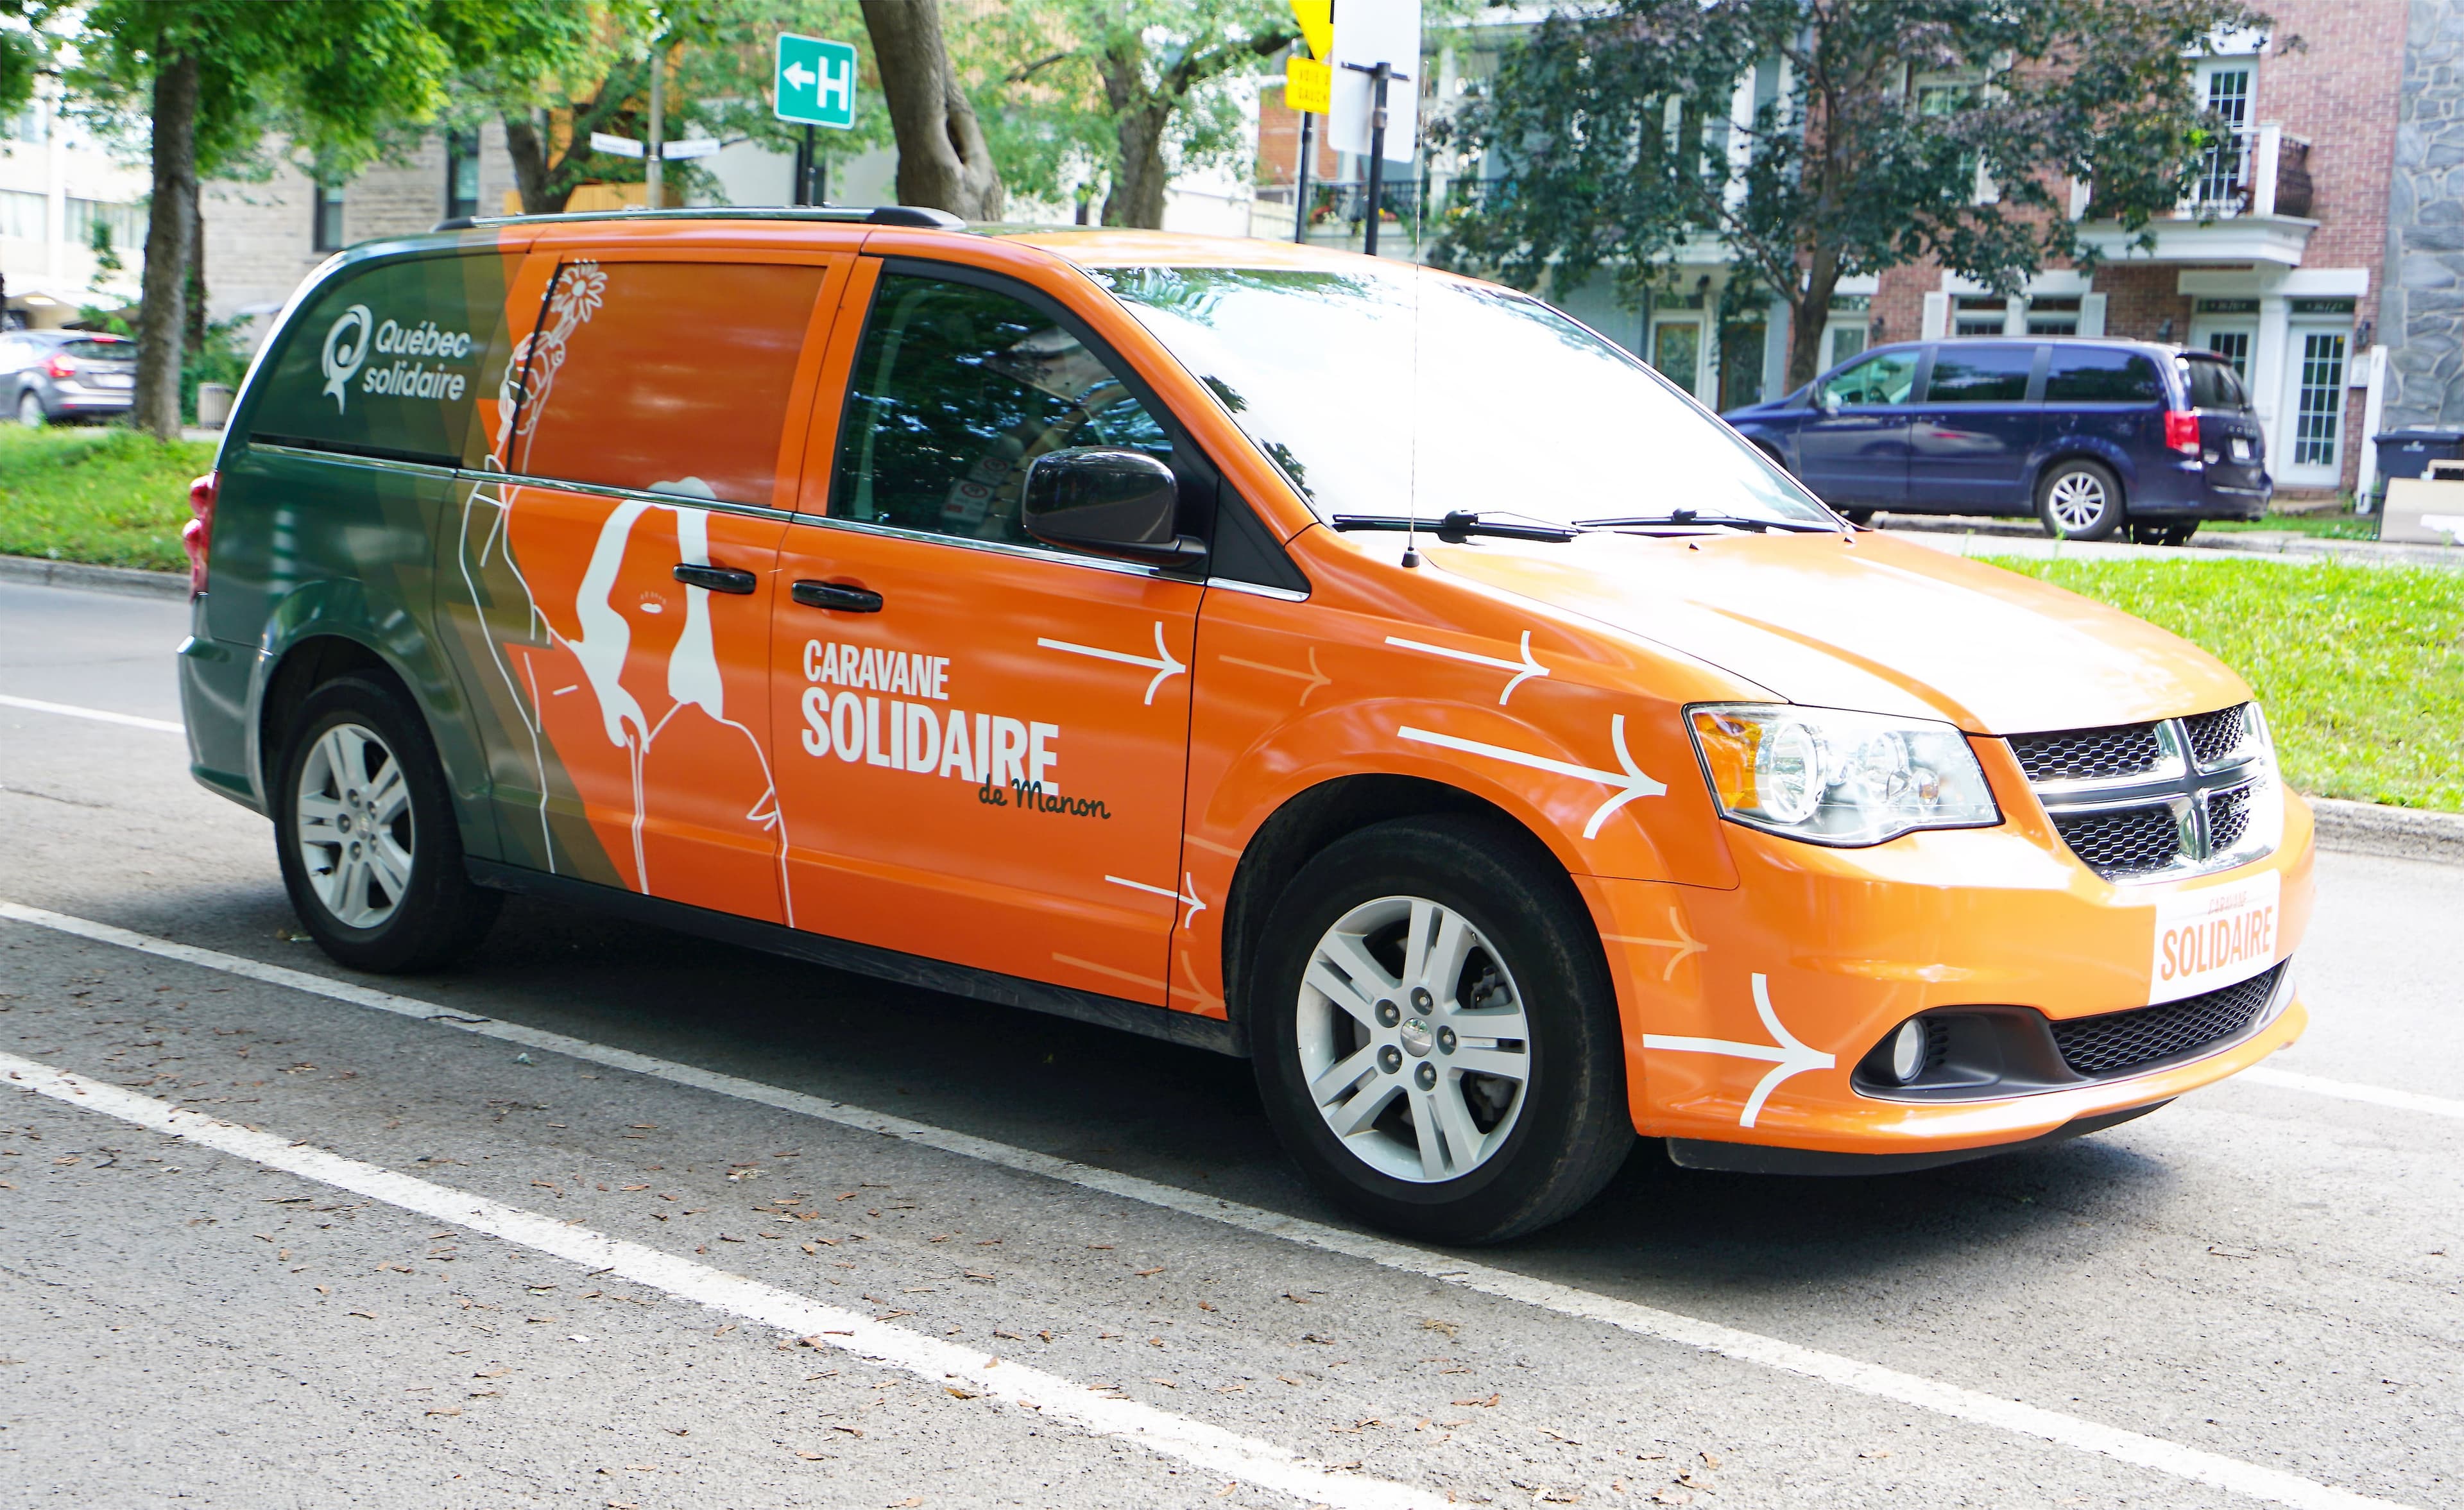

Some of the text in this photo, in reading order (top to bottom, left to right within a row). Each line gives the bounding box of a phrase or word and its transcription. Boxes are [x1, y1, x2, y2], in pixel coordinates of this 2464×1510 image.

[817, 56, 850, 111] H
[375, 319, 471, 358] Québec
[362, 360, 465, 400] solidaire
[803, 639, 950, 700] CARAVANE
[801, 686, 1059, 795] SOLIDAIRE
[979, 773, 1111, 819] de Manon
[2160, 905, 2273, 981] SOLIDAIRE
